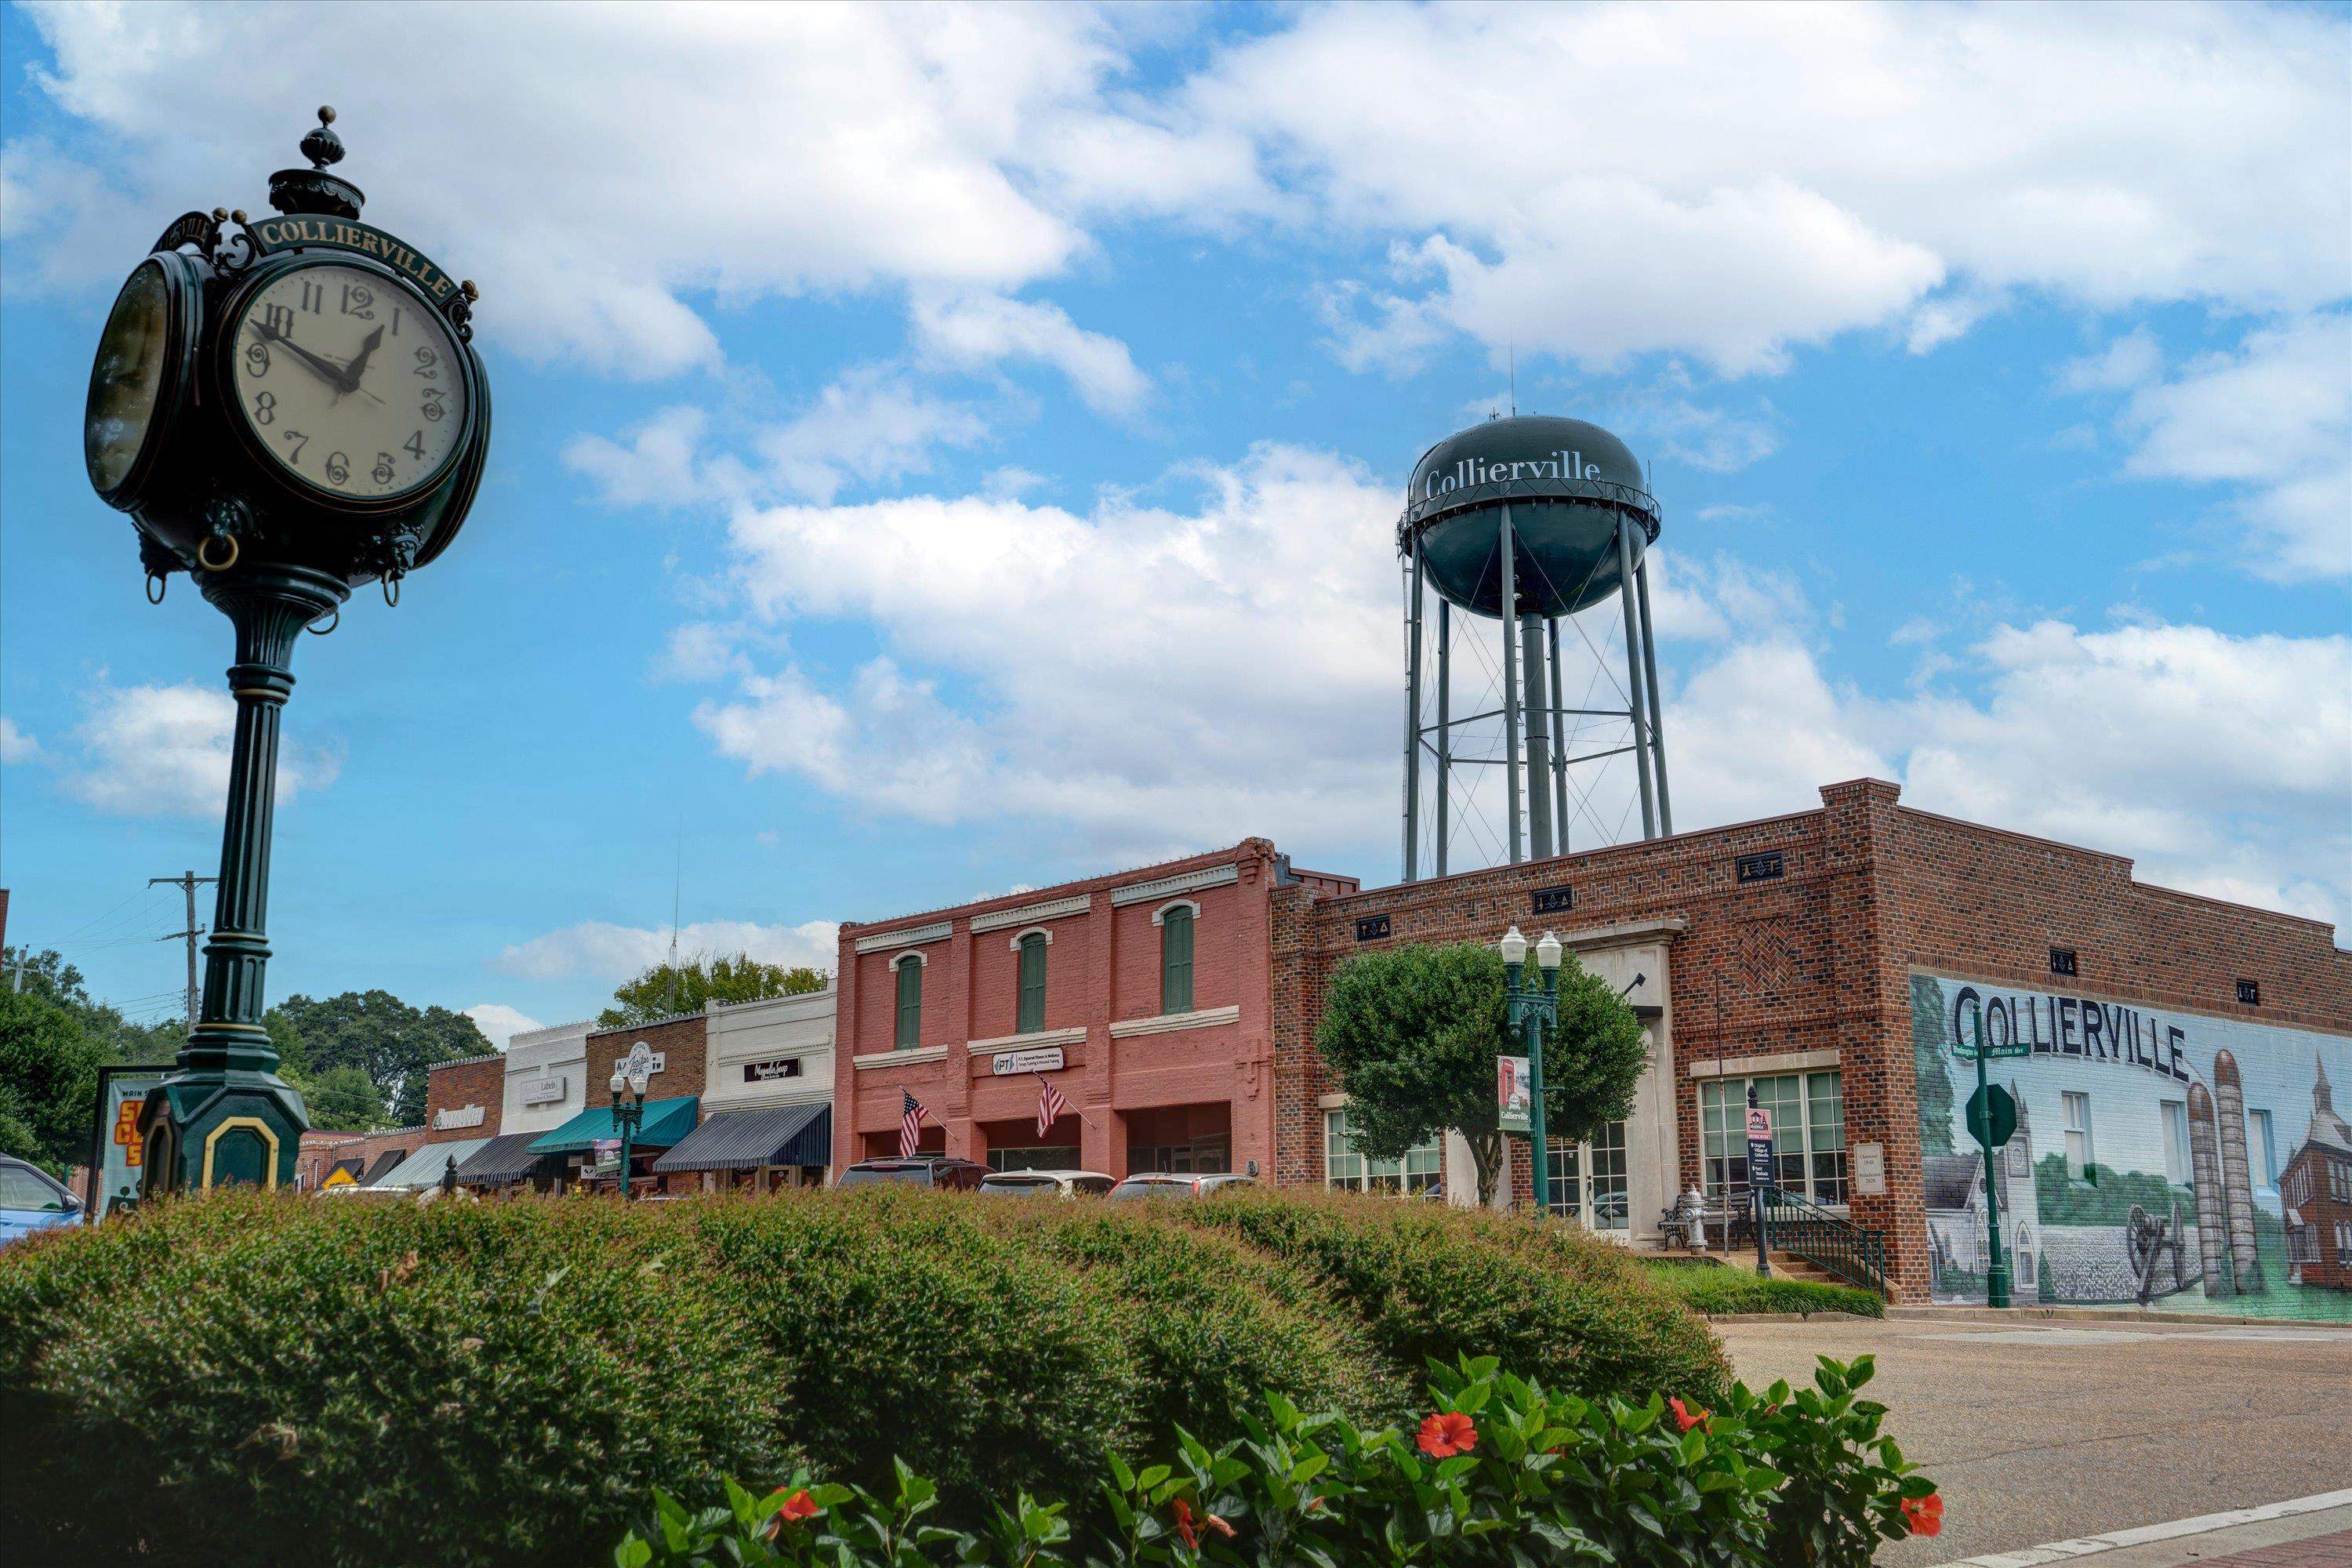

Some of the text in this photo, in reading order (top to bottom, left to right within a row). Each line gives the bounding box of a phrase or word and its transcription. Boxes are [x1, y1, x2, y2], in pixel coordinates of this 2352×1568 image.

[261, 221, 452, 297] COLLIERVILLE
[302, 281, 323, 314] 11
[341, 284, 375, 320] 12
[391, 307, 401, 336] 1
[245, 343, 271, 378] 9
[413, 346, 437, 379] 2
[254, 391, 277, 425] 8
[420, 387, 447, 422] 3
[284, 430, 309, 465] 7
[403, 429, 426, 461] 4
[325, 452, 350, 486] 6
[372, 452, 395, 485] 5
[1425, 450, 1602, 502] Collierville
[1954, 985, 2190, 1083] COLLIERVILLE
[1991, 1047, 2013, 1056] Main
[1501, 1111, 1529, 1120] Collierville
